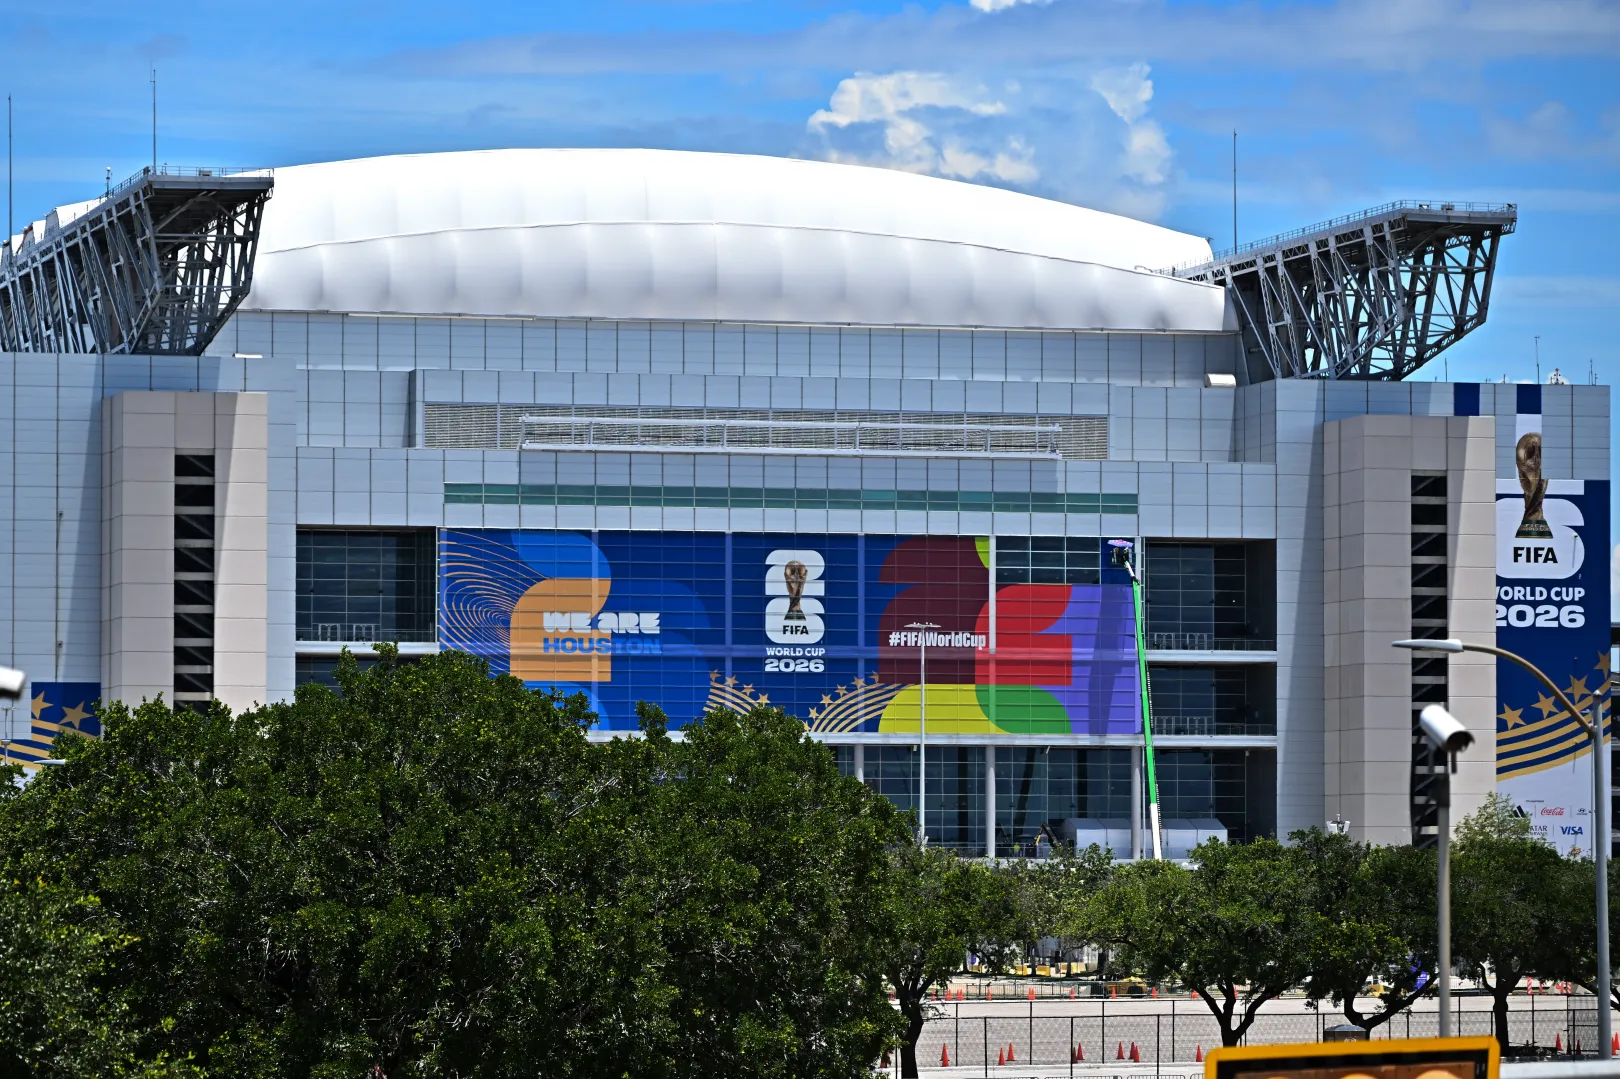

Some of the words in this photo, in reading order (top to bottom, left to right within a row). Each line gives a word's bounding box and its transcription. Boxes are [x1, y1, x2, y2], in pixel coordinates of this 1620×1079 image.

[1513, 546, 1558, 563] FIFA
[1550, 587, 1585, 601] CUP
[543, 612, 591, 634] WE
[598, 612, 660, 634] ARE
[782, 625, 809, 635] FIFA
[543, 637, 661, 654] HOUSTON
[889, 632, 986, 650] #FIFAWorldCup
[766, 647, 803, 657] WORLD
[805, 647, 825, 657] CUP
[765, 659, 824, 672] 2026
[1559, 826, 1584, 836] VISA
